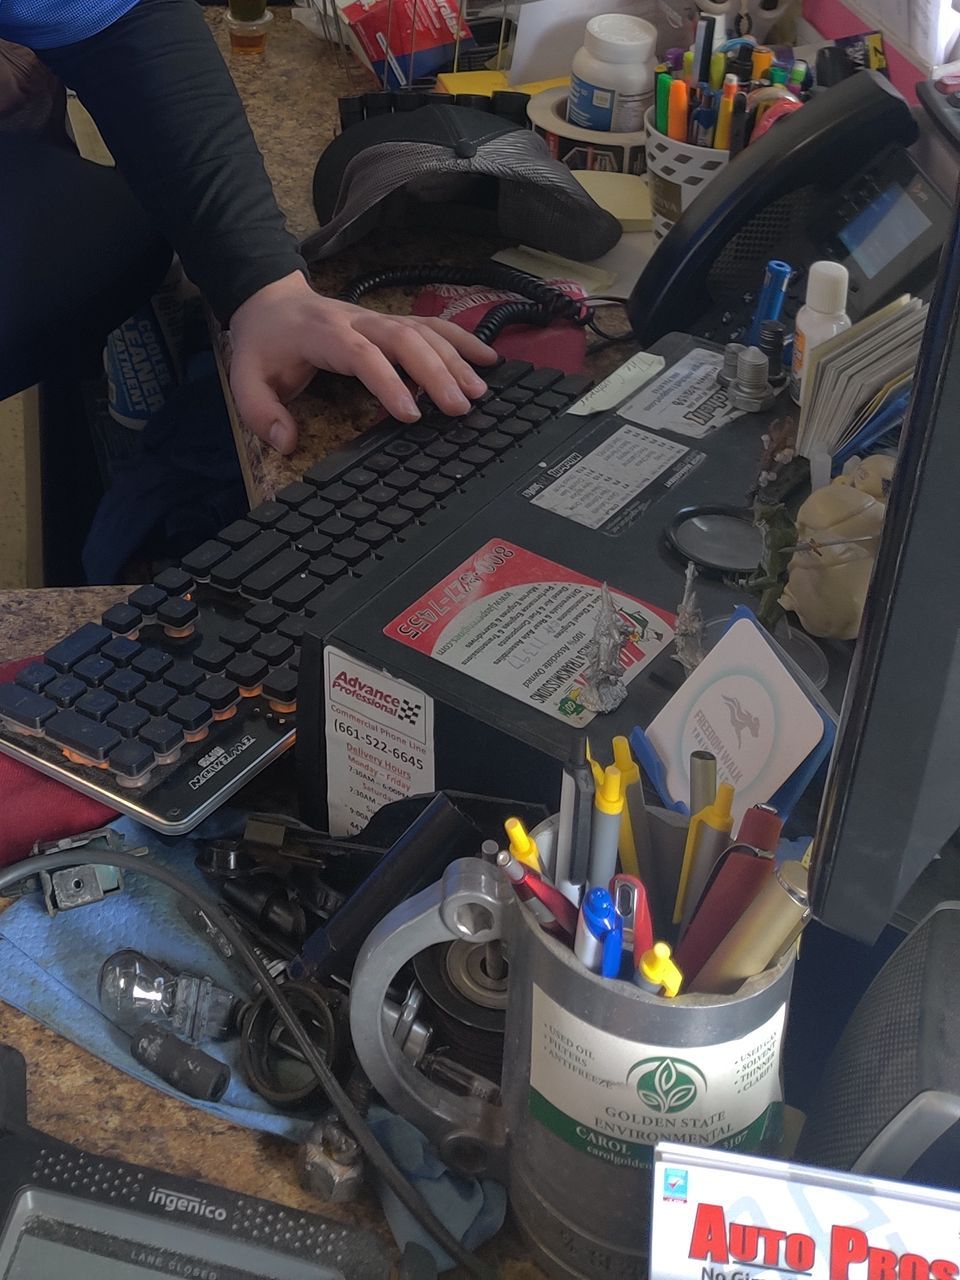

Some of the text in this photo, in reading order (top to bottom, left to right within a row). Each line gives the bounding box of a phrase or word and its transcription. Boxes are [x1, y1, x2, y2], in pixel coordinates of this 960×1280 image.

[543, 644, 570, 669] Associate
[334, 671, 401, 707] Advance
[522, 668, 545, 689] Owned
[529, 658, 585, 704] TRANSMISSIONS
[332, 680, 398, 717] Professional
[330, 704, 426, 755] Commercial Phone Line
[333, 718, 424, 771] (661-522-6645
[694, 709, 722, 754] FREEDOM
[720, 749, 743, 784] WALK
[346, 742, 412, 781] Delivery Hours
[347, 754, 378, 777] Monday
[386, 773, 412, 793] Friday
[362, 782, 393, 802] Saturda
[549, 1026, 595, 1060] USED OIL
[549, 1038, 588, 1067] FILTERS
[742, 1040, 776, 1072] SOLVENT
[548, 1051, 613, 1090] ANTIFREEZE
[740, 1051, 775, 1081] THINNER
[595, 1117, 734, 1143] ENVIRONMENTAL
[605, 1106, 726, 1128] GOLDEN STATE
[576, 1126, 631, 1156] CAROL
[147, 1186, 227, 1221] ingenico
[130, 1250, 218, 1280] LANE CLOSED
